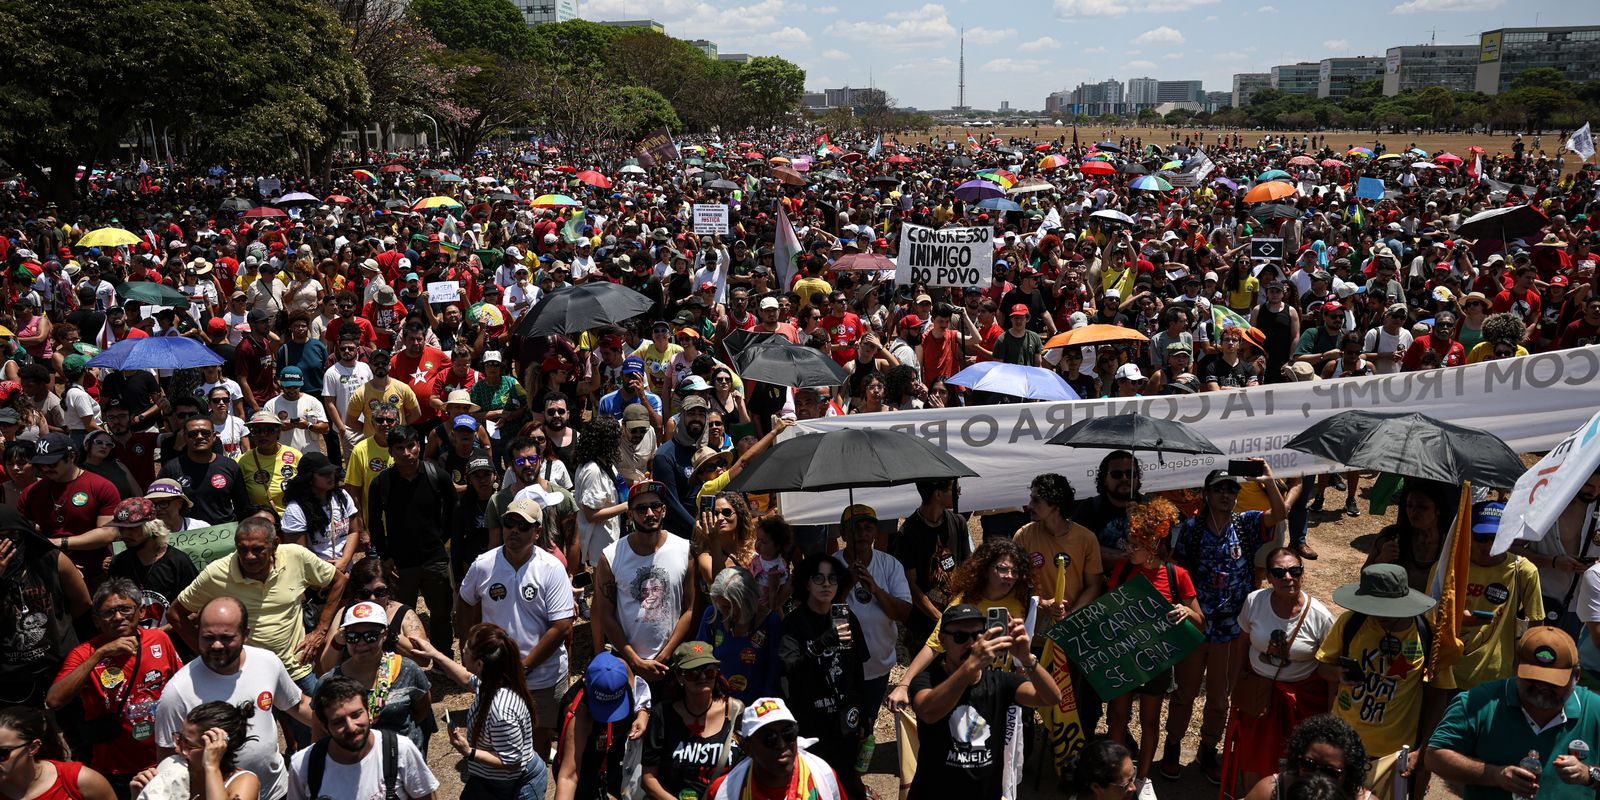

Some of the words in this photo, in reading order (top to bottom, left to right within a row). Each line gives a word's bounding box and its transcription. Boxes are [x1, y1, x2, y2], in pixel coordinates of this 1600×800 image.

[907, 227, 988, 243] CONGRESSO
[909, 244, 972, 267] INIMIGO
[911, 267, 931, 284] DO
[936, 267, 980, 285] POVO
[168, 529, 231, 547] GRESSO
[1046, 625, 1069, 641] EM
[1066, 602, 1107, 629] TERRA
[1110, 586, 1135, 606] DE
[1068, 628, 1100, 656] ZÉ
[1099, 596, 1164, 641] CARIOCA
[1079, 650, 1110, 674] PATO
[1110, 628, 1151, 659] DONALD
[1105, 665, 1134, 688] SE
[1135, 640, 1177, 671] CRIA
[1004, 707, 1017, 746] DARISTA
[946, 749, 992, 764] MARIELLE
